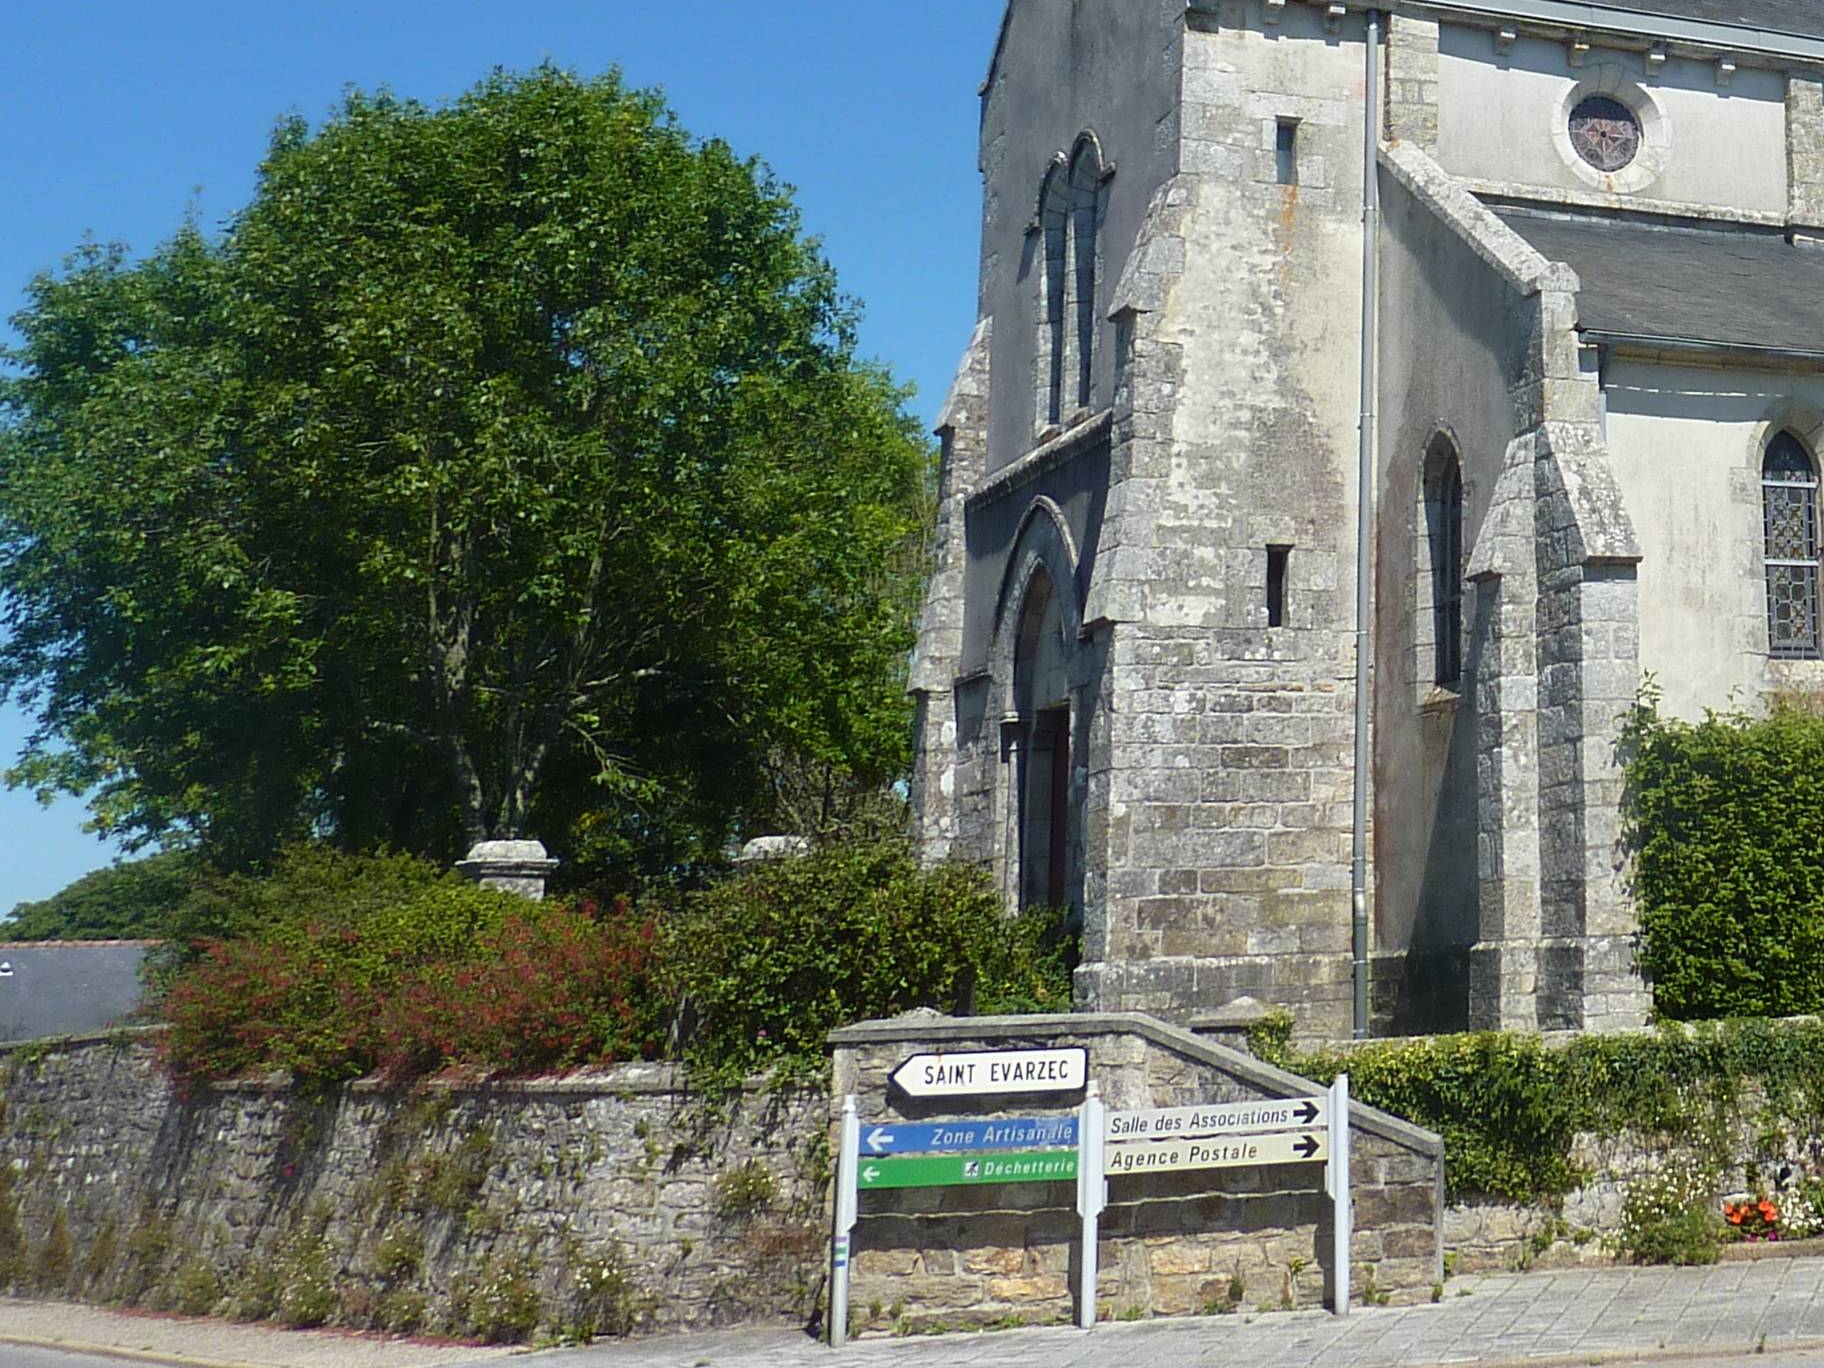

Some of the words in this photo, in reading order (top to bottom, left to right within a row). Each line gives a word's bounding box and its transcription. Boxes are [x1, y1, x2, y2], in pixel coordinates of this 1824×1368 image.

[924, 1064, 976, 1085] SAINT
[990, 1060, 1069, 1082] EVARZEC
[1111, 1116, 1148, 1134] Salle
[1155, 1115, 1182, 1131] des
[1189, 1107, 1288, 1129] Associations
[931, 1128, 974, 1145] Zone
[983, 1123, 1072, 1143] Artisanale
[984, 1158, 1075, 1176] Déchetterie
[1111, 1150, 1179, 1171] Agence
[1189, 1143, 1258, 1163] Postale
